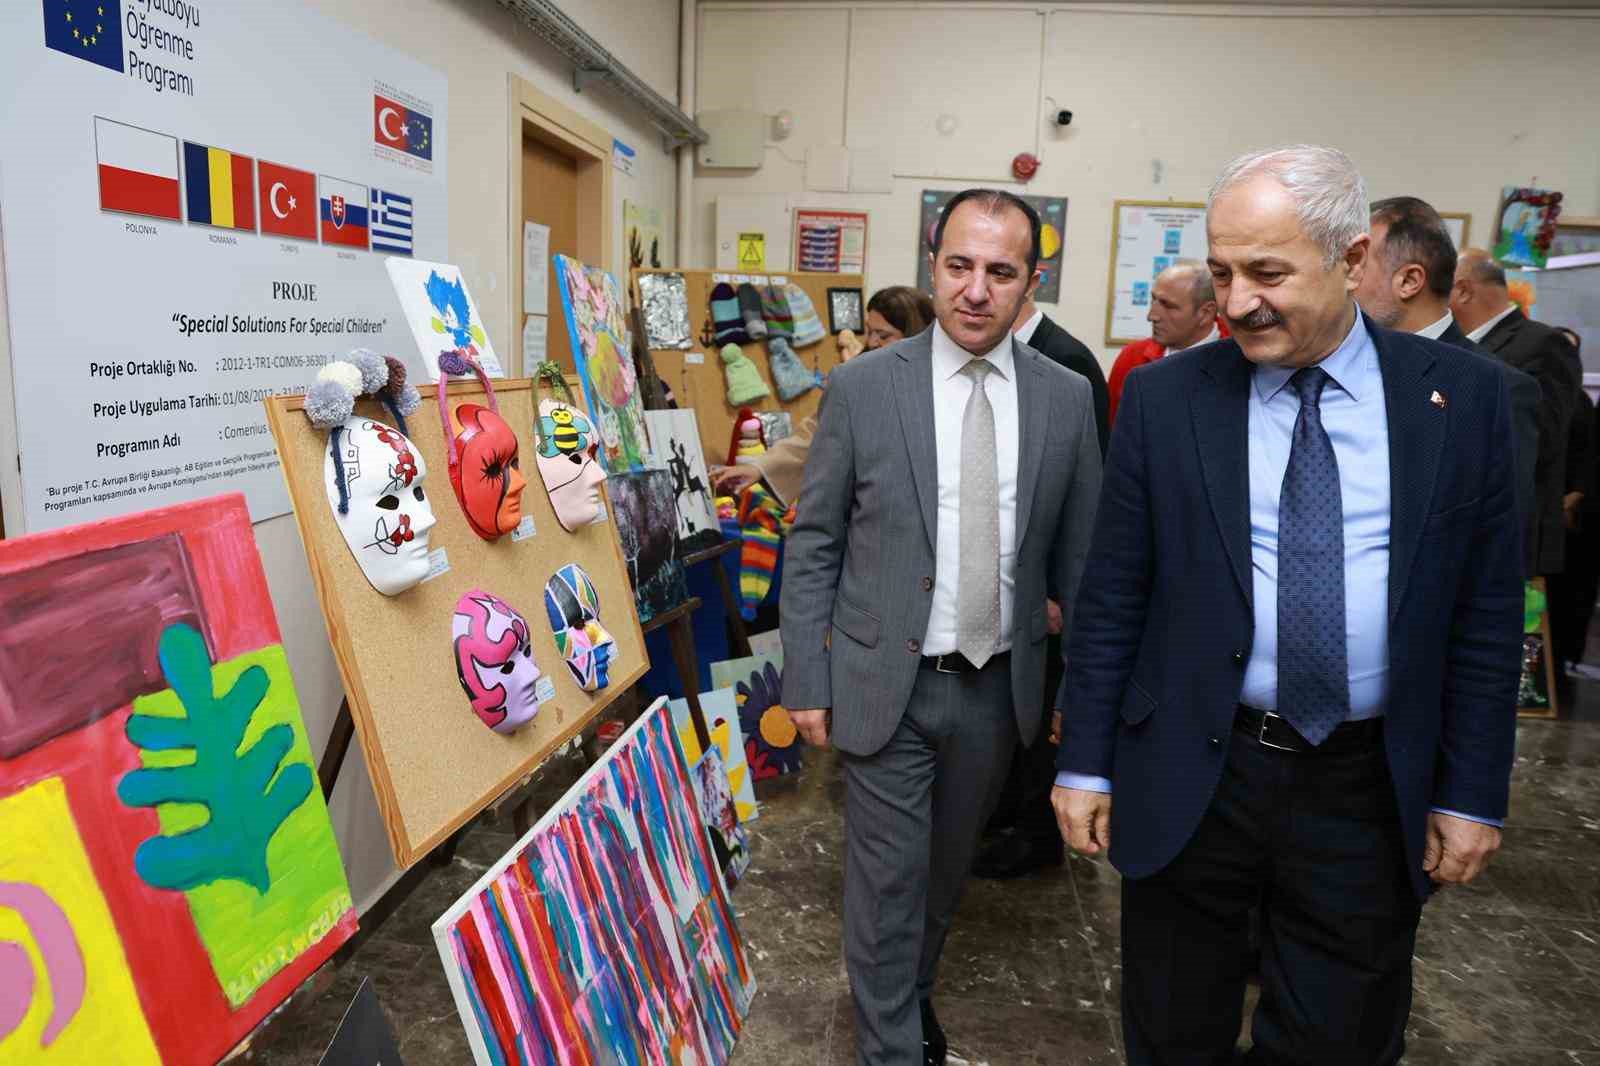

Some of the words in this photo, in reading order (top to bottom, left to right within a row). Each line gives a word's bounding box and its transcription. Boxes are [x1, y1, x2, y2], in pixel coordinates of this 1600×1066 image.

[126, 4, 194, 60] Öğrenme
[129, 50, 194, 96] Programı
[125, 223, 158, 235] POLONYA
[272, 281, 318, 301] PROJE
[232, 315, 286, 334] Solutions
[289, 317, 308, 334] For
[309, 318, 344, 336] Special
[90, 362, 124, 380] Proje
[127, 359, 176, 377] Ortaklığı
[178, 360, 197, 374] No.
[93, 402, 127, 419] Proje
[129, 397, 186, 417] Uygulama
[189, 394, 222, 408] Tarihi:
[97, 438, 160, 458] Programın
[162, 432, 181, 448] Adı
[224, 423, 268, 440] Comenius
[62, 483, 83, 496] proje
[102, 475, 128, 488] Avrupa
[184, 463, 194, 472] AB
[44, 495, 92, 512] Programları
[93, 488, 137, 502] kapsamında
[147, 481, 172, 492] Avrupa
